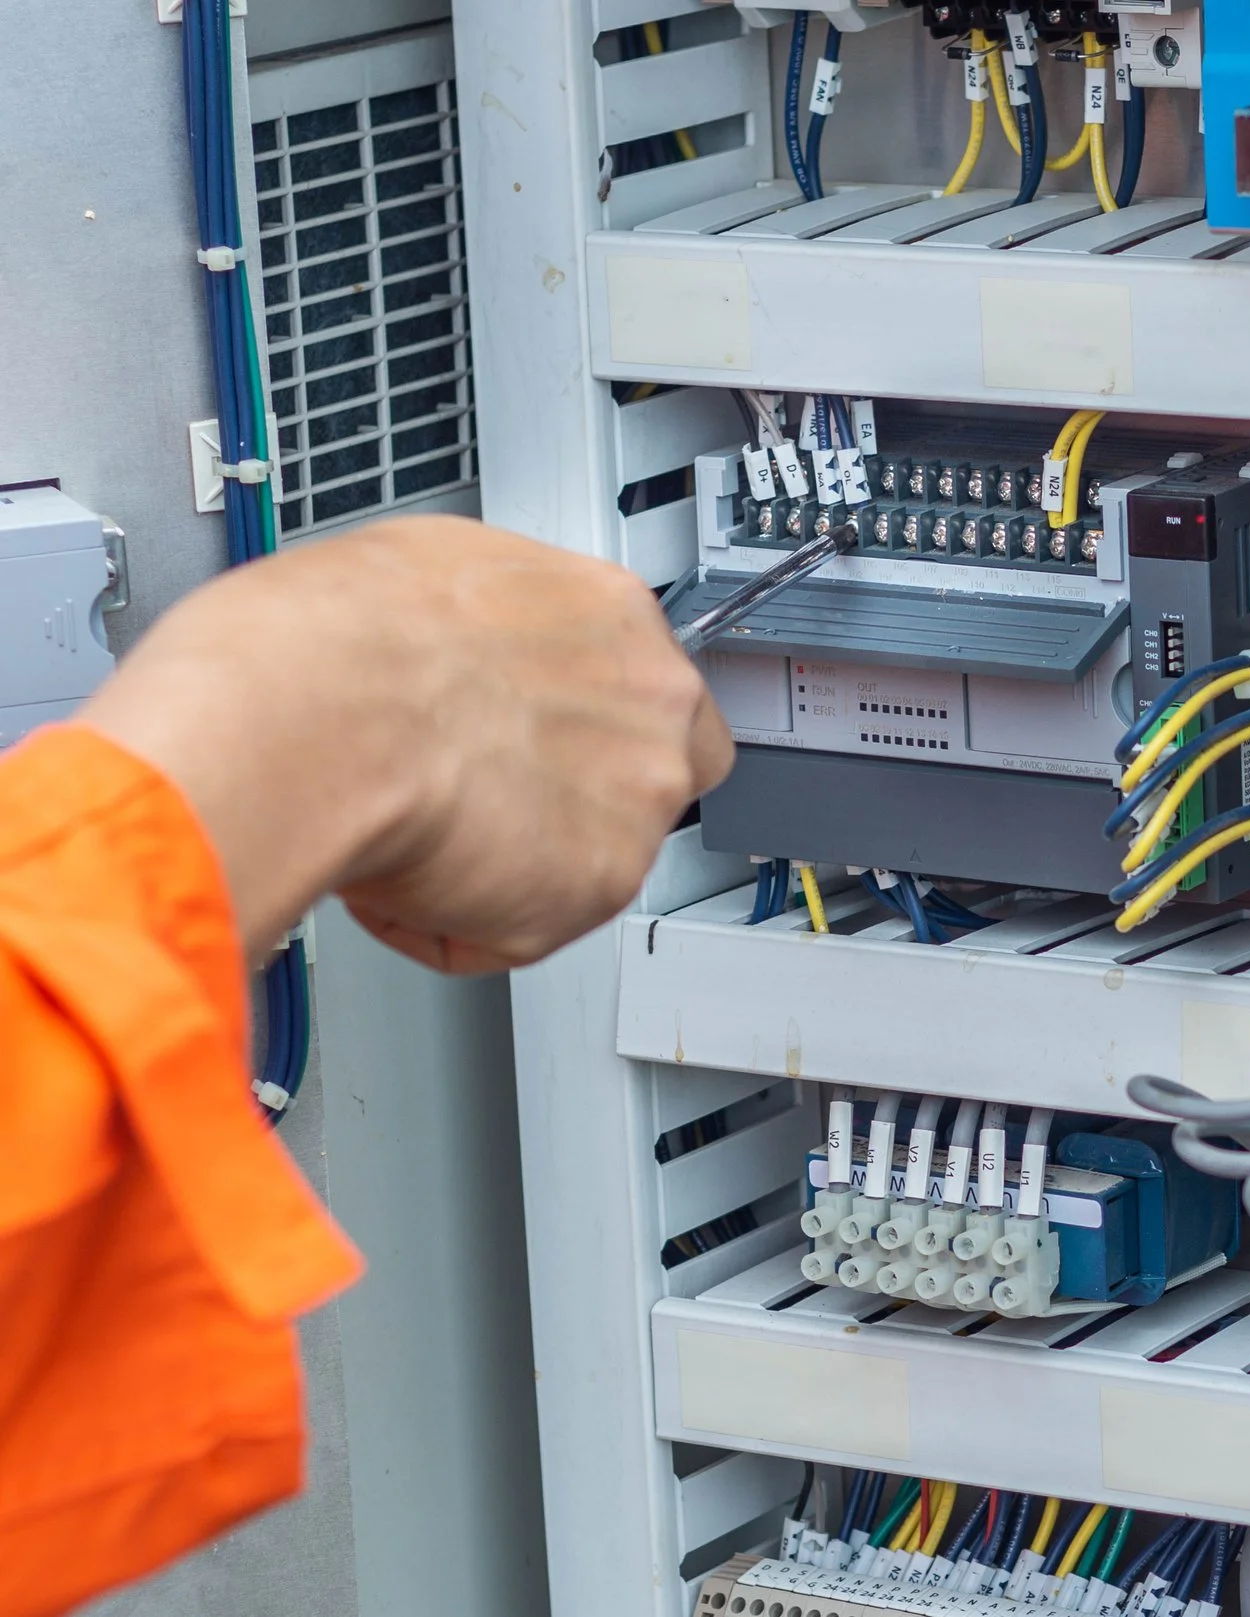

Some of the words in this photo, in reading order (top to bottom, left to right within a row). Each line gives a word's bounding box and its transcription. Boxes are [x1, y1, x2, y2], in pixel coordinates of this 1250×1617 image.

[1014, 35, 1025, 50] WB
[967, 65, 976, 88] N24
[816, 79, 827, 103] FAN
[1091, 85, 1102, 110] N24
[861, 423, 873, 439] EA
[758, 468, 769, 484] D+
[1049, 475, 1060, 497] N24
[1166, 516, 1182, 525] RUN
[1144, 629, 1158, 638] CH0
[1144, 652, 1159, 660] CH2
[810, 664, 836, 677] PWR
[1145, 663, 1159, 671] CH3
[812, 685, 835, 697] RUN
[857, 682, 878, 693] OUT
[813, 705, 836, 717] ERR
[829, 1130, 840, 1149] W2
[908, 1145, 919, 1163] V2
[982, 1153, 995, 1171] U2
[946, 1161, 956, 1178] V1
[1020, 1170, 1031, 1186] U1
